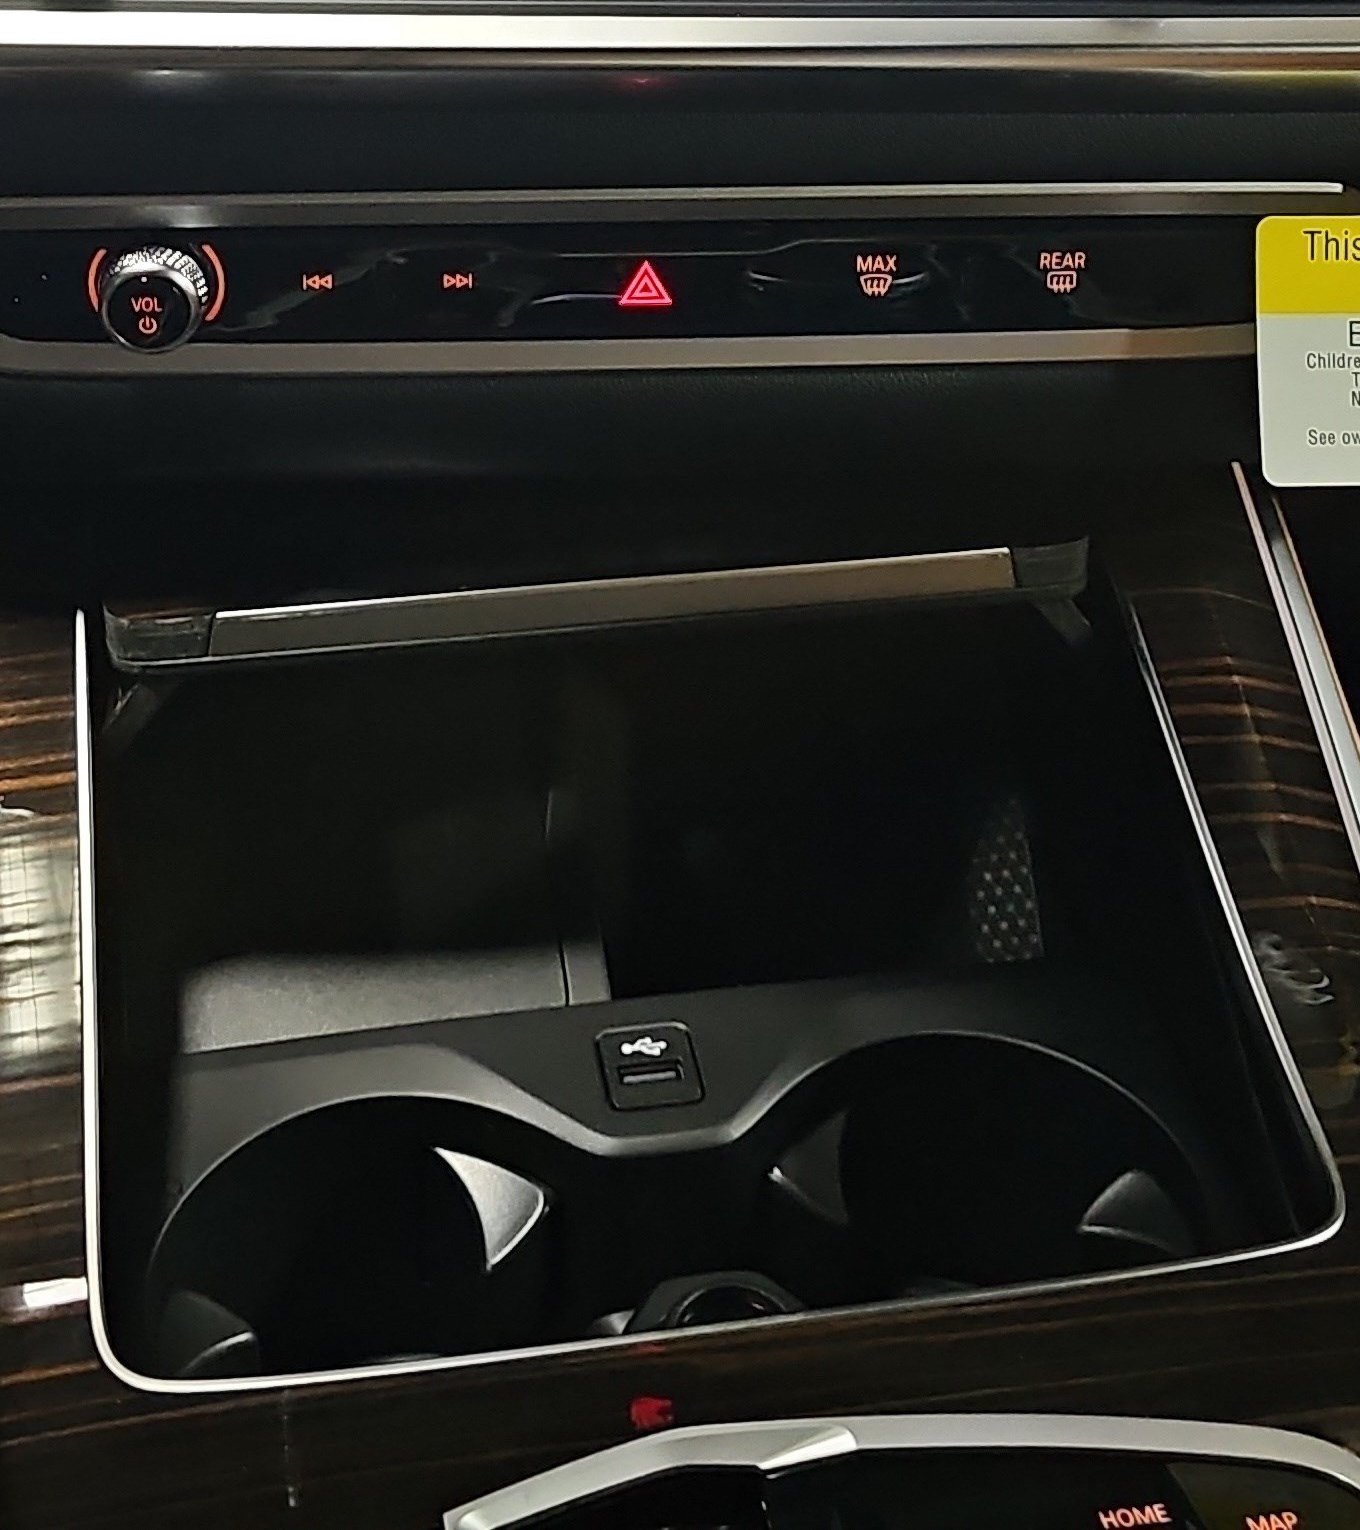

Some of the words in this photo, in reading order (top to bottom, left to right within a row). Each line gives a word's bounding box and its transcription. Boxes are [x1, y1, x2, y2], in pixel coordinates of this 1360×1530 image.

[857, 255, 897, 272] MAX
[1040, 252, 1086, 269] REAR
[131, 296, 162, 313] VOL
[1308, 429, 1336, 445] See
[1098, 1503, 1172, 1529] HOME
[1246, 1512, 1298, 1530] MAP
